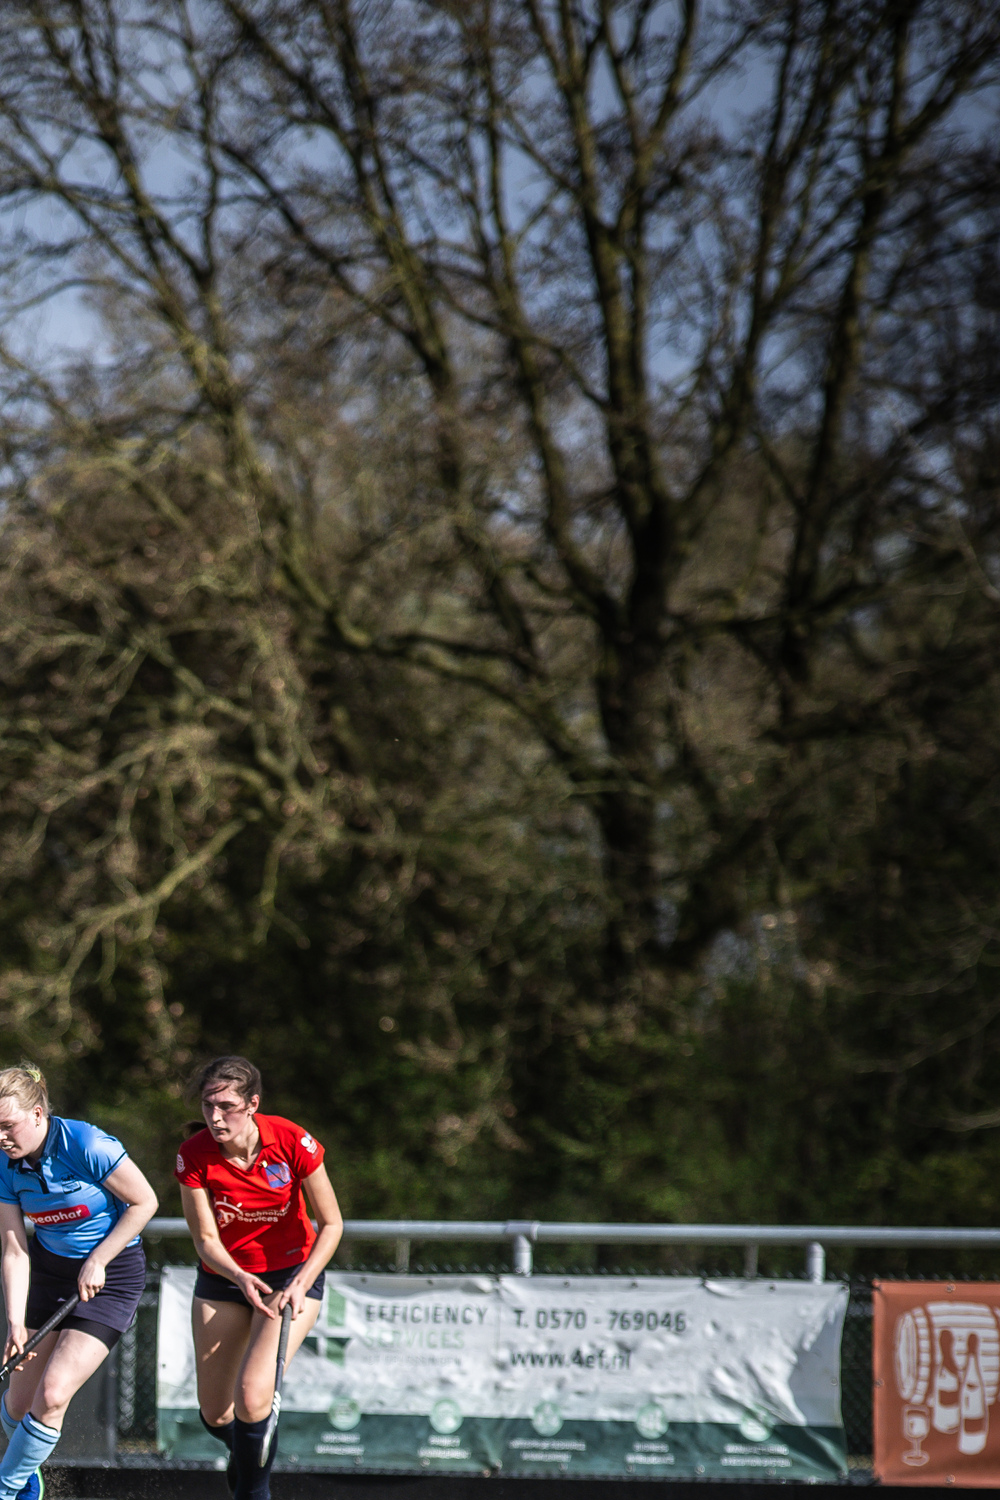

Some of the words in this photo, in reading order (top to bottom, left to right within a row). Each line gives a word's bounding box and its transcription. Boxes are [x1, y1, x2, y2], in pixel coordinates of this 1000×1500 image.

[28, 1209, 82, 1224] beaphar
[365, 1303, 488, 1325] EFFICIENCY
[535, 1309, 587, 1330] 0570
[607, 1310, 687, 1333] 769046
[363, 1330, 465, 1349] SERVICES
